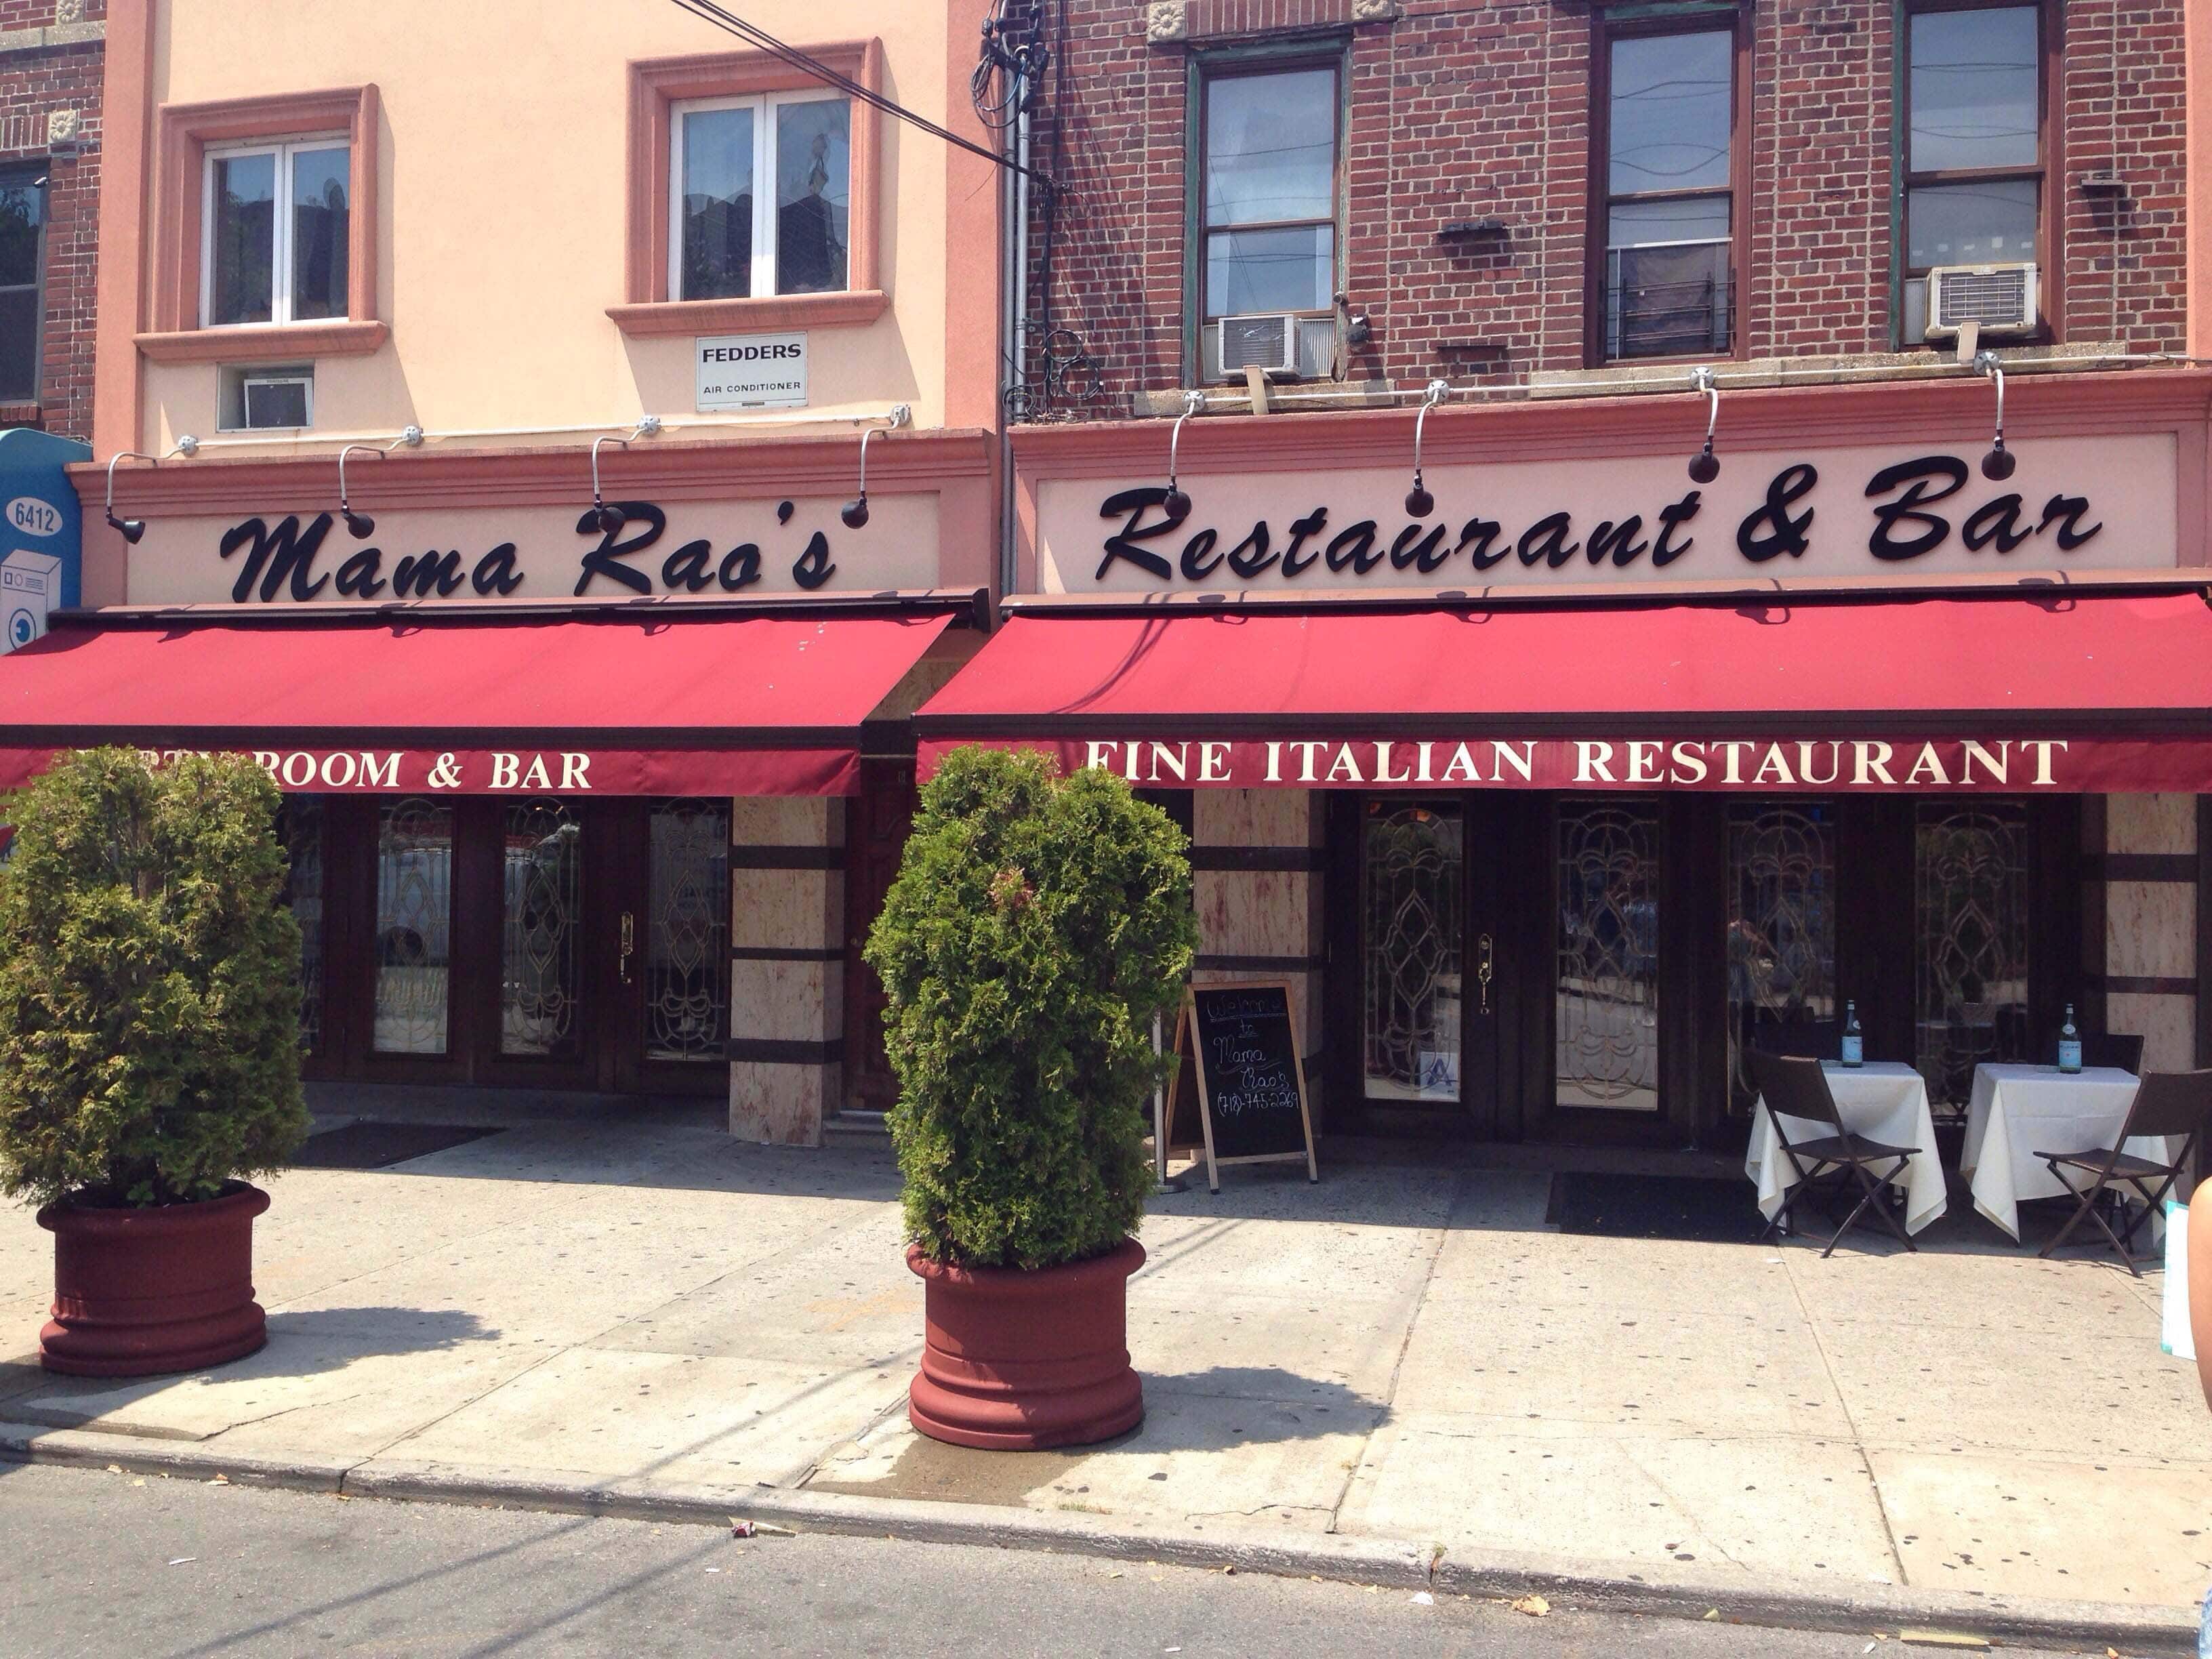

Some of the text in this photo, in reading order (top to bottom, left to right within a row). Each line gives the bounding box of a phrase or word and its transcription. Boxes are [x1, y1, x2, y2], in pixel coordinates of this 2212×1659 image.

[703, 344, 802, 363] FEDDERS
[703, 381, 801, 394] AIR CONDITIONER
[15, 502, 54, 533] 6412
[1094, 455, 2103, 581] Restaurant & Bar
[220, 500, 837, 604] Mama Rao's
[251, 750, 405, 789] ROOM
[427, 752, 464, 789] &
[488, 752, 592, 789] BAR
[1085, 739, 2068, 785] FINE ITALIAN RESTAURANT
[1213, 1034, 1266, 1064] Mama
